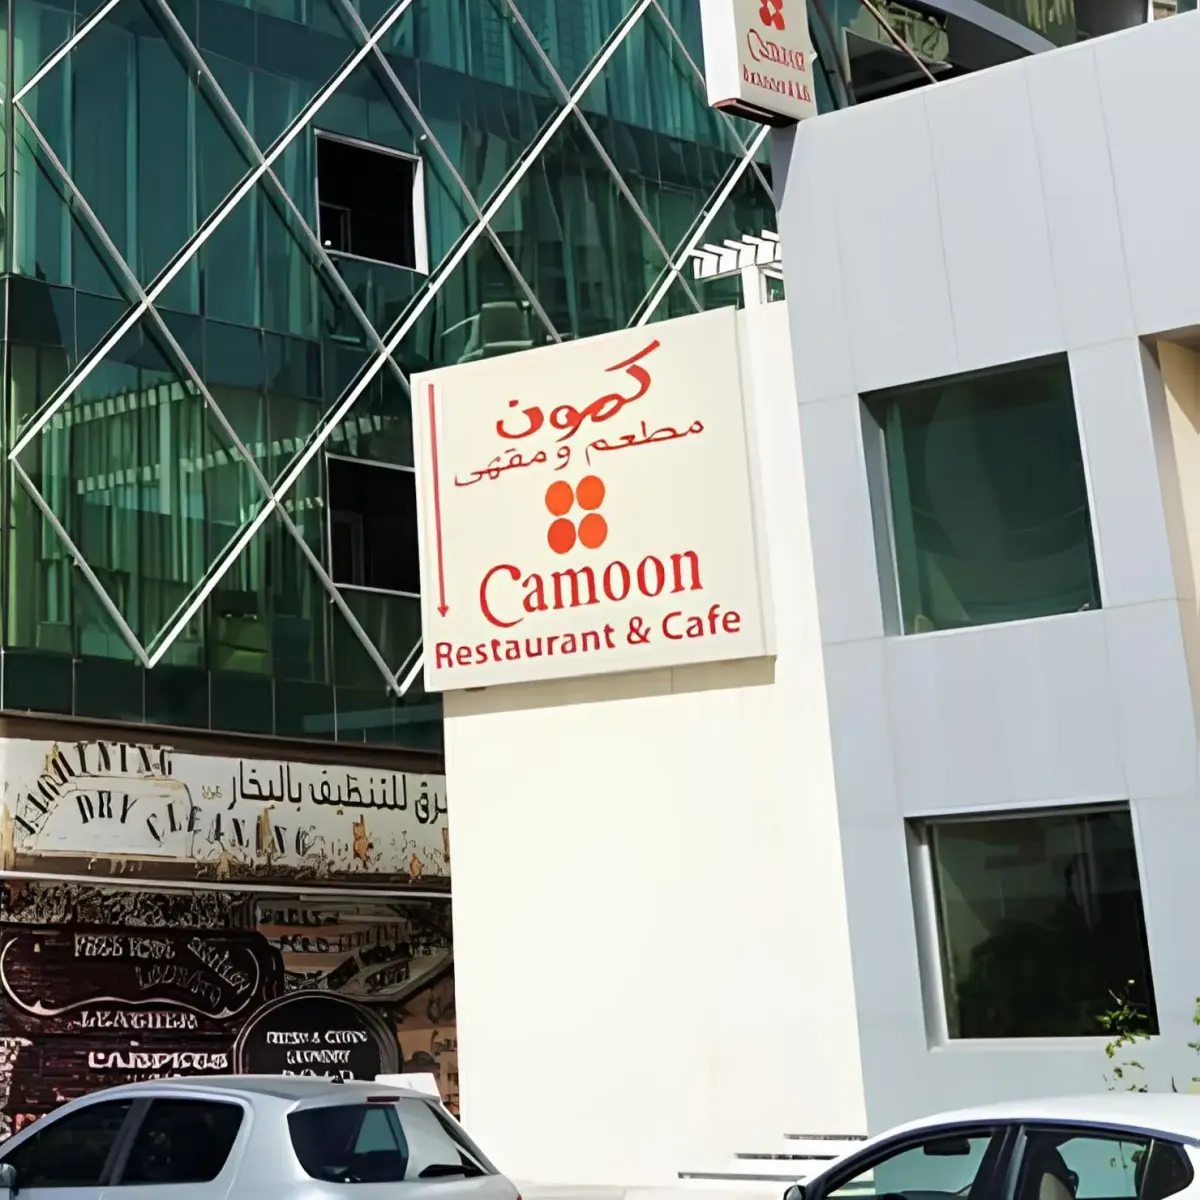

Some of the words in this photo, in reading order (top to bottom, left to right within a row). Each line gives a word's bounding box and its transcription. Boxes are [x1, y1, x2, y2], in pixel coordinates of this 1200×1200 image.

[496, 339, 660, 442] كمون
[586, 419, 704, 466] مطعم
[480, 550, 703, 628] Camoon
[435, 624, 615, 669] Restaurant
[626, 616, 651, 644] &
[662, 604, 741, 639] Cafe
[77, 790, 138, 824] DRY
